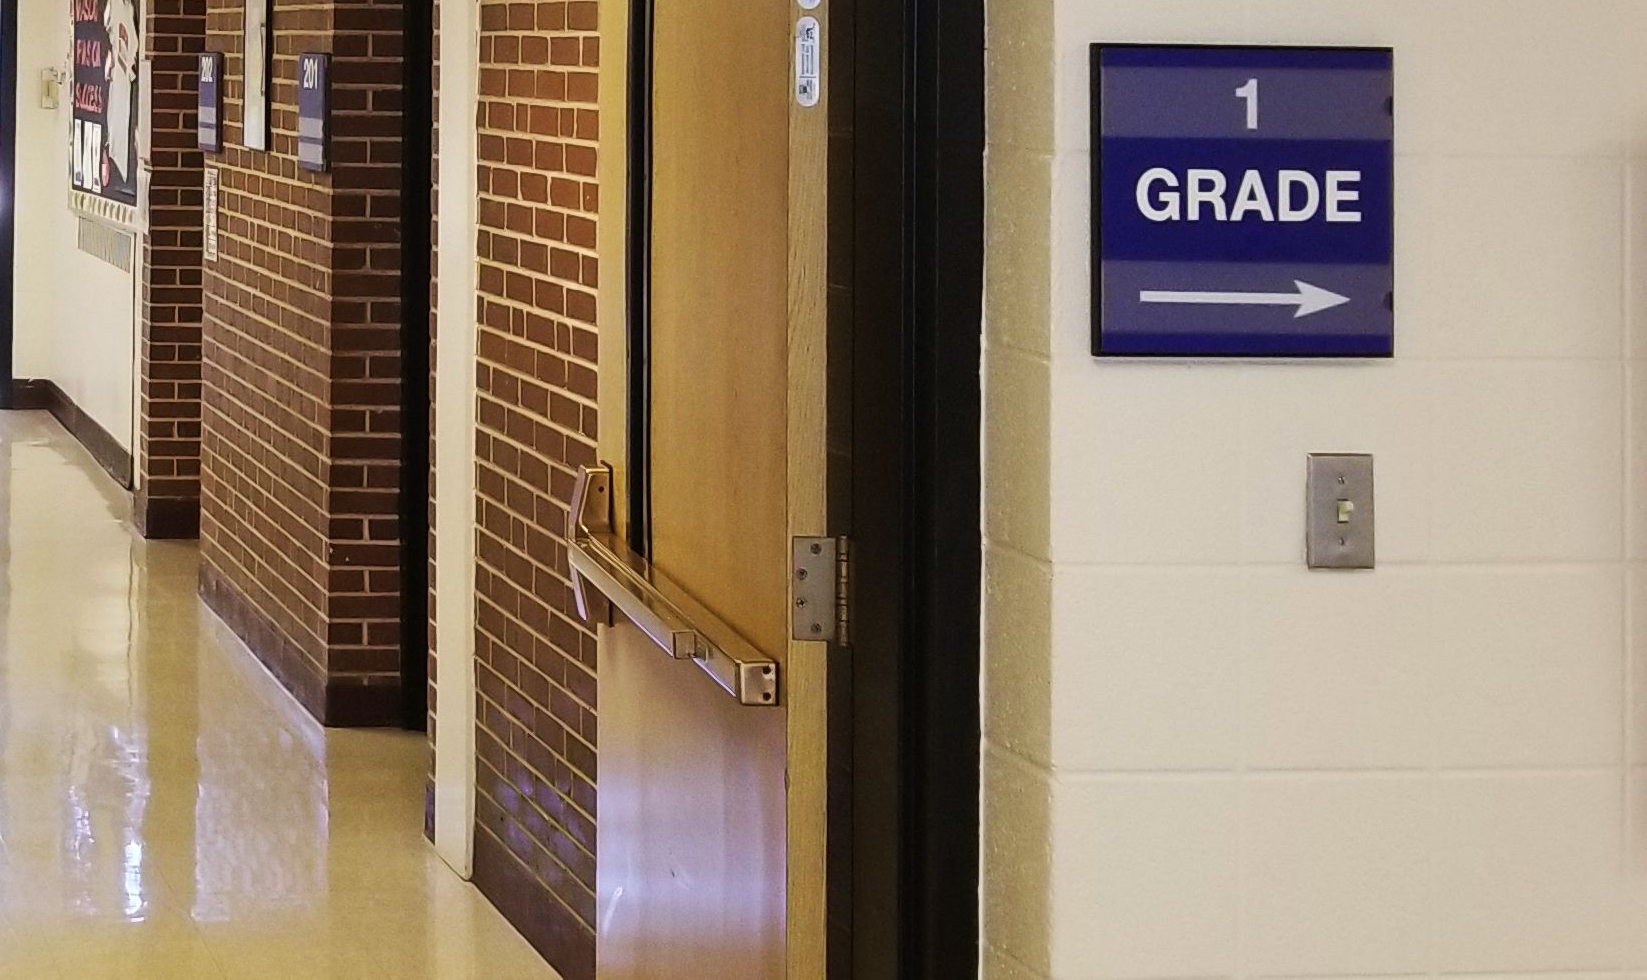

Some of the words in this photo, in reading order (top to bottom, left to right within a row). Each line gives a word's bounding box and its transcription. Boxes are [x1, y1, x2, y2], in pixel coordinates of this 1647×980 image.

[200, 56, 214, 83] 202
[303, 58, 319, 90] 201
[1234, 78, 1258, 130] 1
[1135, 167, 1362, 222] GRADE
